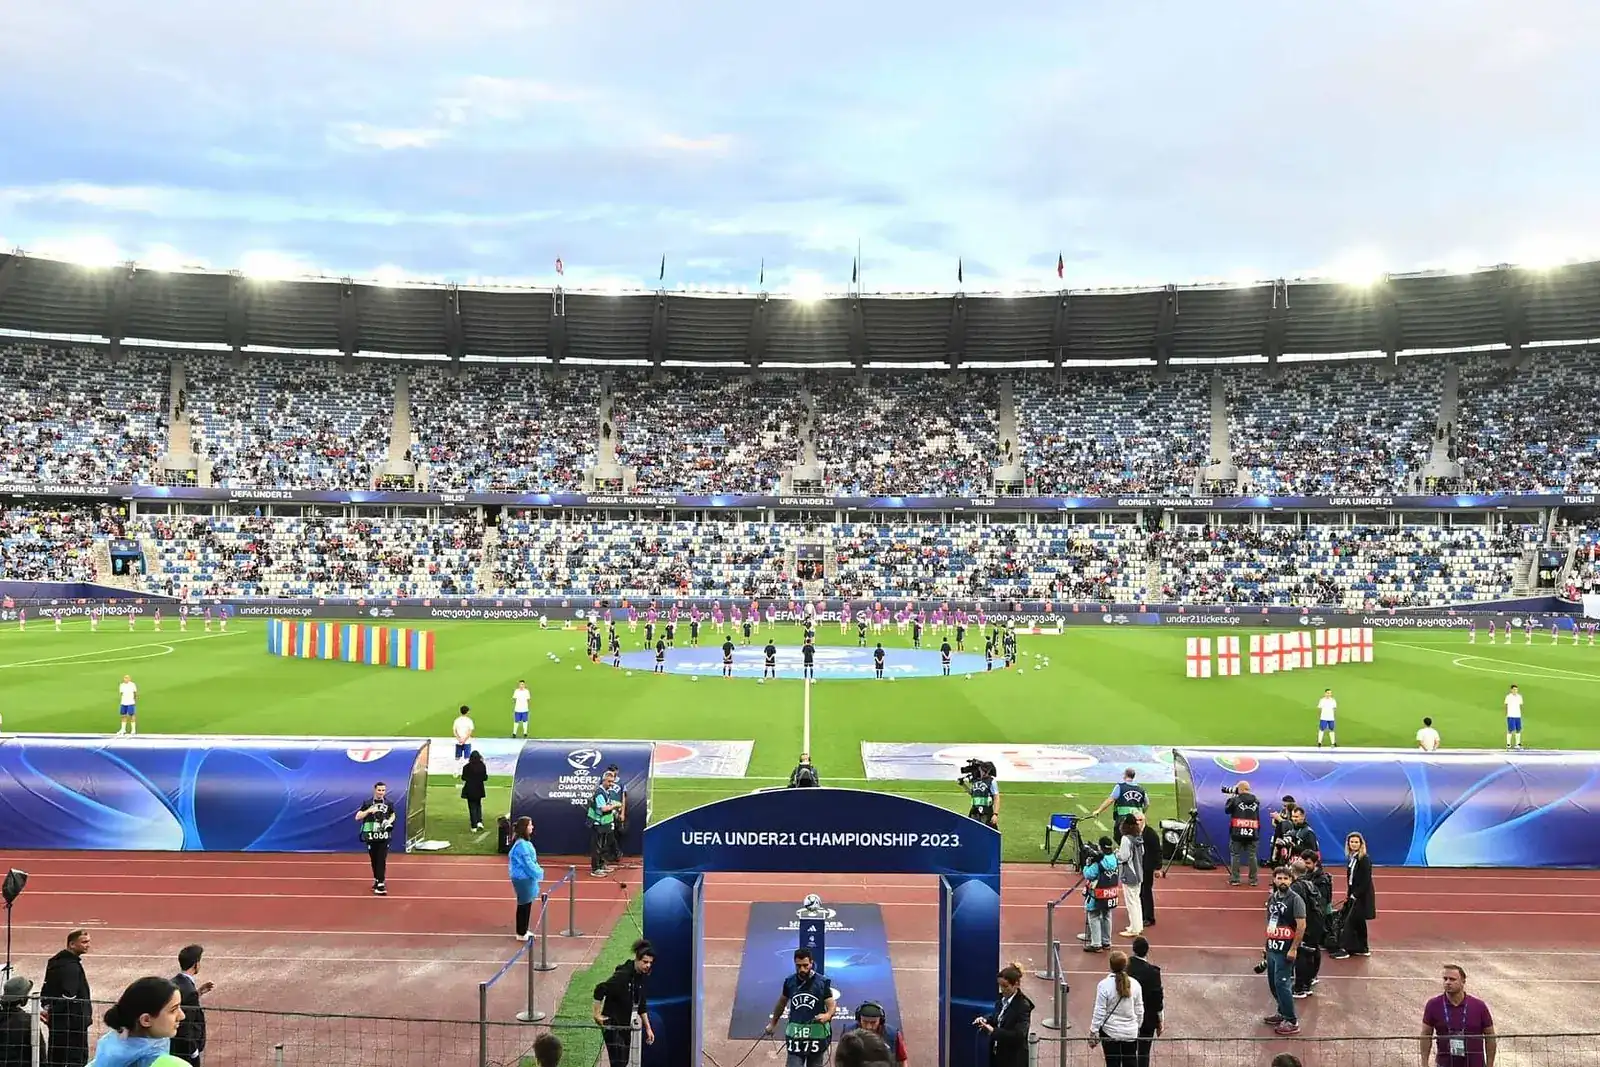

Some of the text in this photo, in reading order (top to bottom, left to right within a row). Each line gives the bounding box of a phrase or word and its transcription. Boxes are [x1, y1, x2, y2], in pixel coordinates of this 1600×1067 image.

[44, 485, 85, 494] ROMANIA
[87, 486, 109, 495] 2023
[230, 490, 293, 499] UEFA UNDER 21
[586, 496, 618, 504] GEORGIA
[624, 496, 657, 504] ROMANIA
[658, 497, 677, 505] 2023
[799, 498, 825, 506] UNDER
[825, 498, 834, 506] 21
[970, 498, 995, 506] TBILISI
[1117, 499, 1151, 507] GEORGIA
[1157, 499, 1192, 507] ROMANIA
[1194, 499, 1213, 507] 2023
[1328, 497, 1393, 506] UEFA UNDER 21
[1562, 495, 1595, 504] TBILISI
[240, 604, 313, 616] under21tickets.ge
[1166, 615, 1240, 625] under21tickets.ge
[1240, 828, 1254, 837] 162
[681, 831, 960, 847] UEFA UNDER21 CHAMPIONSHIP 2023
[787, 1039, 820, 1053] 1175
